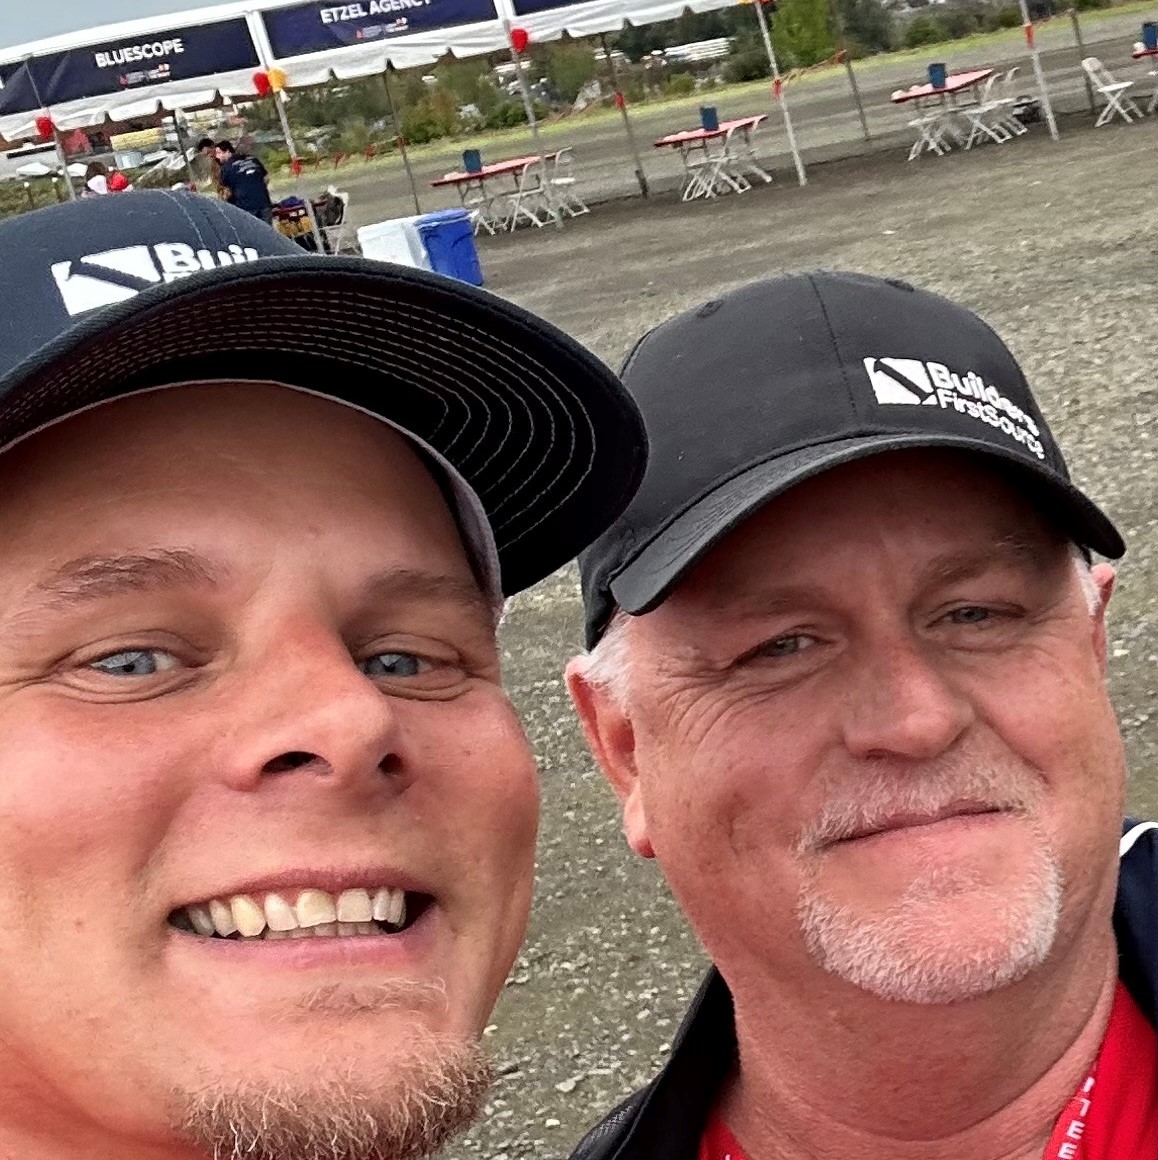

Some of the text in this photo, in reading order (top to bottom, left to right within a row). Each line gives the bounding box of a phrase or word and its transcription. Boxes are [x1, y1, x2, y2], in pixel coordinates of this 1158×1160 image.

[320, 3, 367, 24] ETZEL
[95, 38, 185, 68] BLUESCOPE
[926, 361, 1040, 436] Builders
[936, 388, 1045, 459] FirstSource
